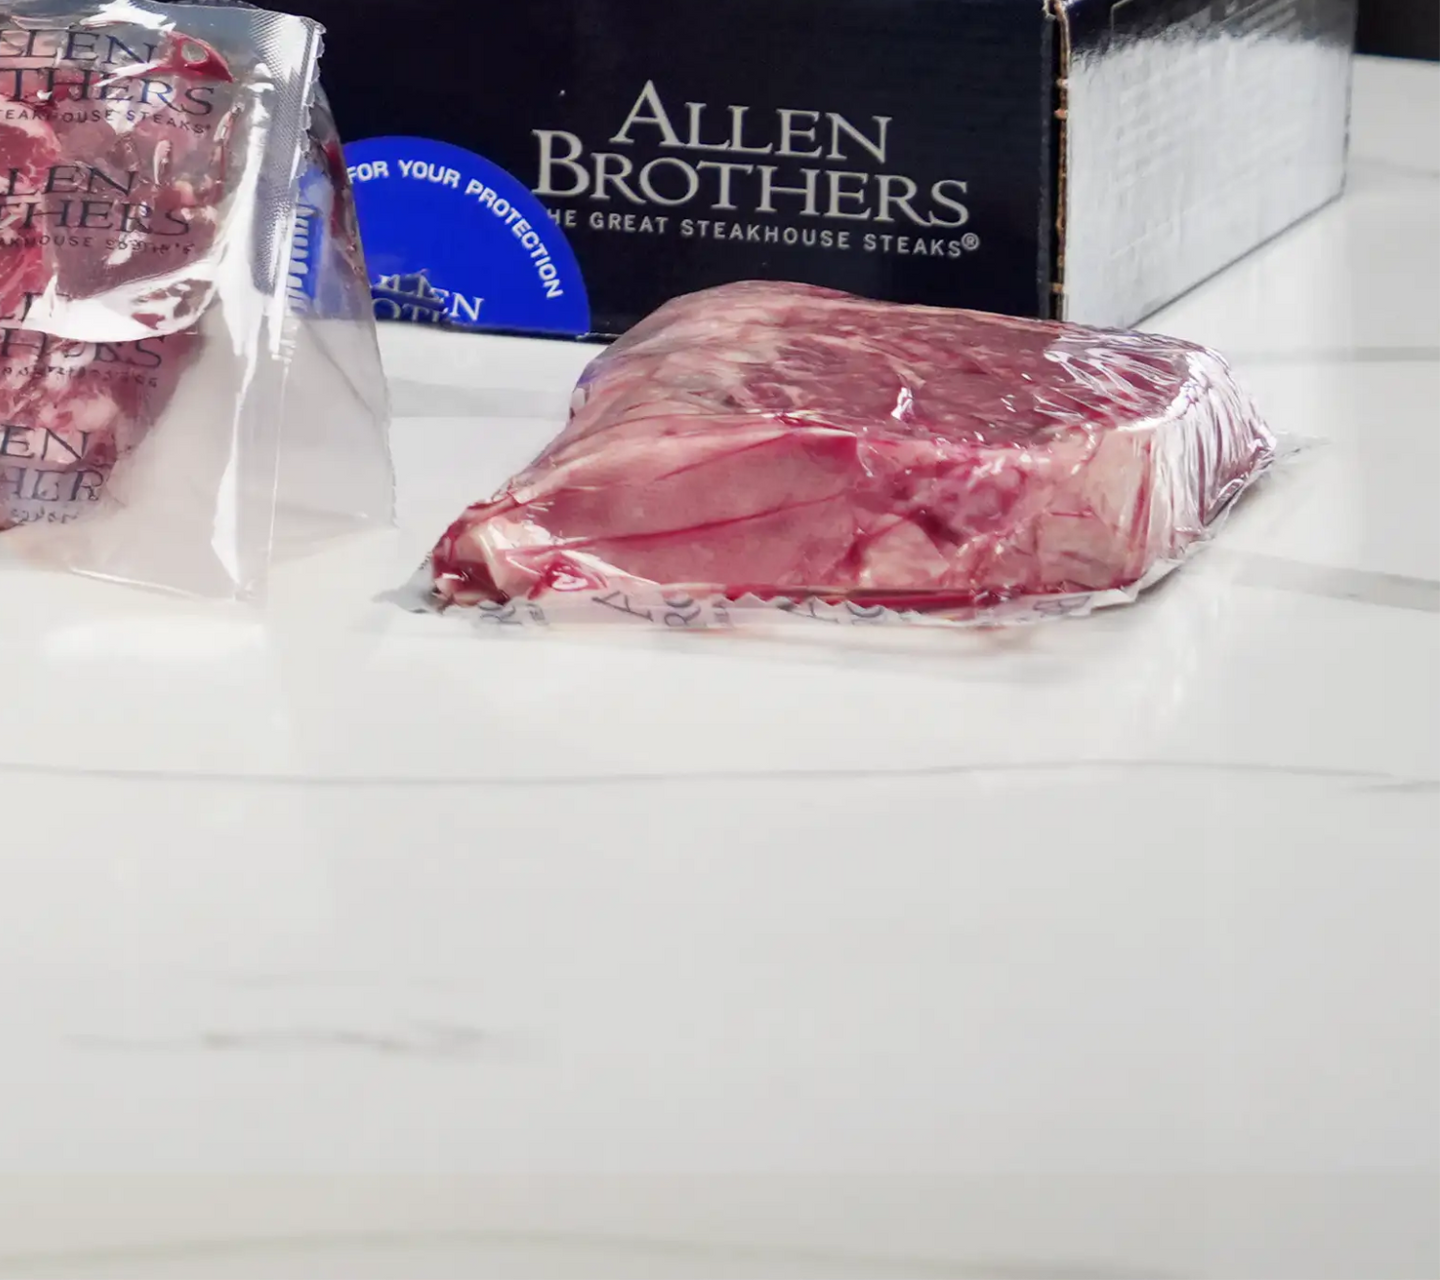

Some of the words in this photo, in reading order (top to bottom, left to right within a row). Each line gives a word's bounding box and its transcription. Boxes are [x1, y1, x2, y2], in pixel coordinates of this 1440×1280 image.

[609, 80, 893, 164] ALLEN
[531, 129, 970, 228] BROTHERS
[347, 160, 390, 184] FOR
[398, 159, 461, 189] YOUR
[465, 178, 564, 300] PROTECTION
[548, 208, 577, 228] HE
[589, 211, 669, 234] GREAT
[680, 218, 851, 249] STEAKHOUSE
